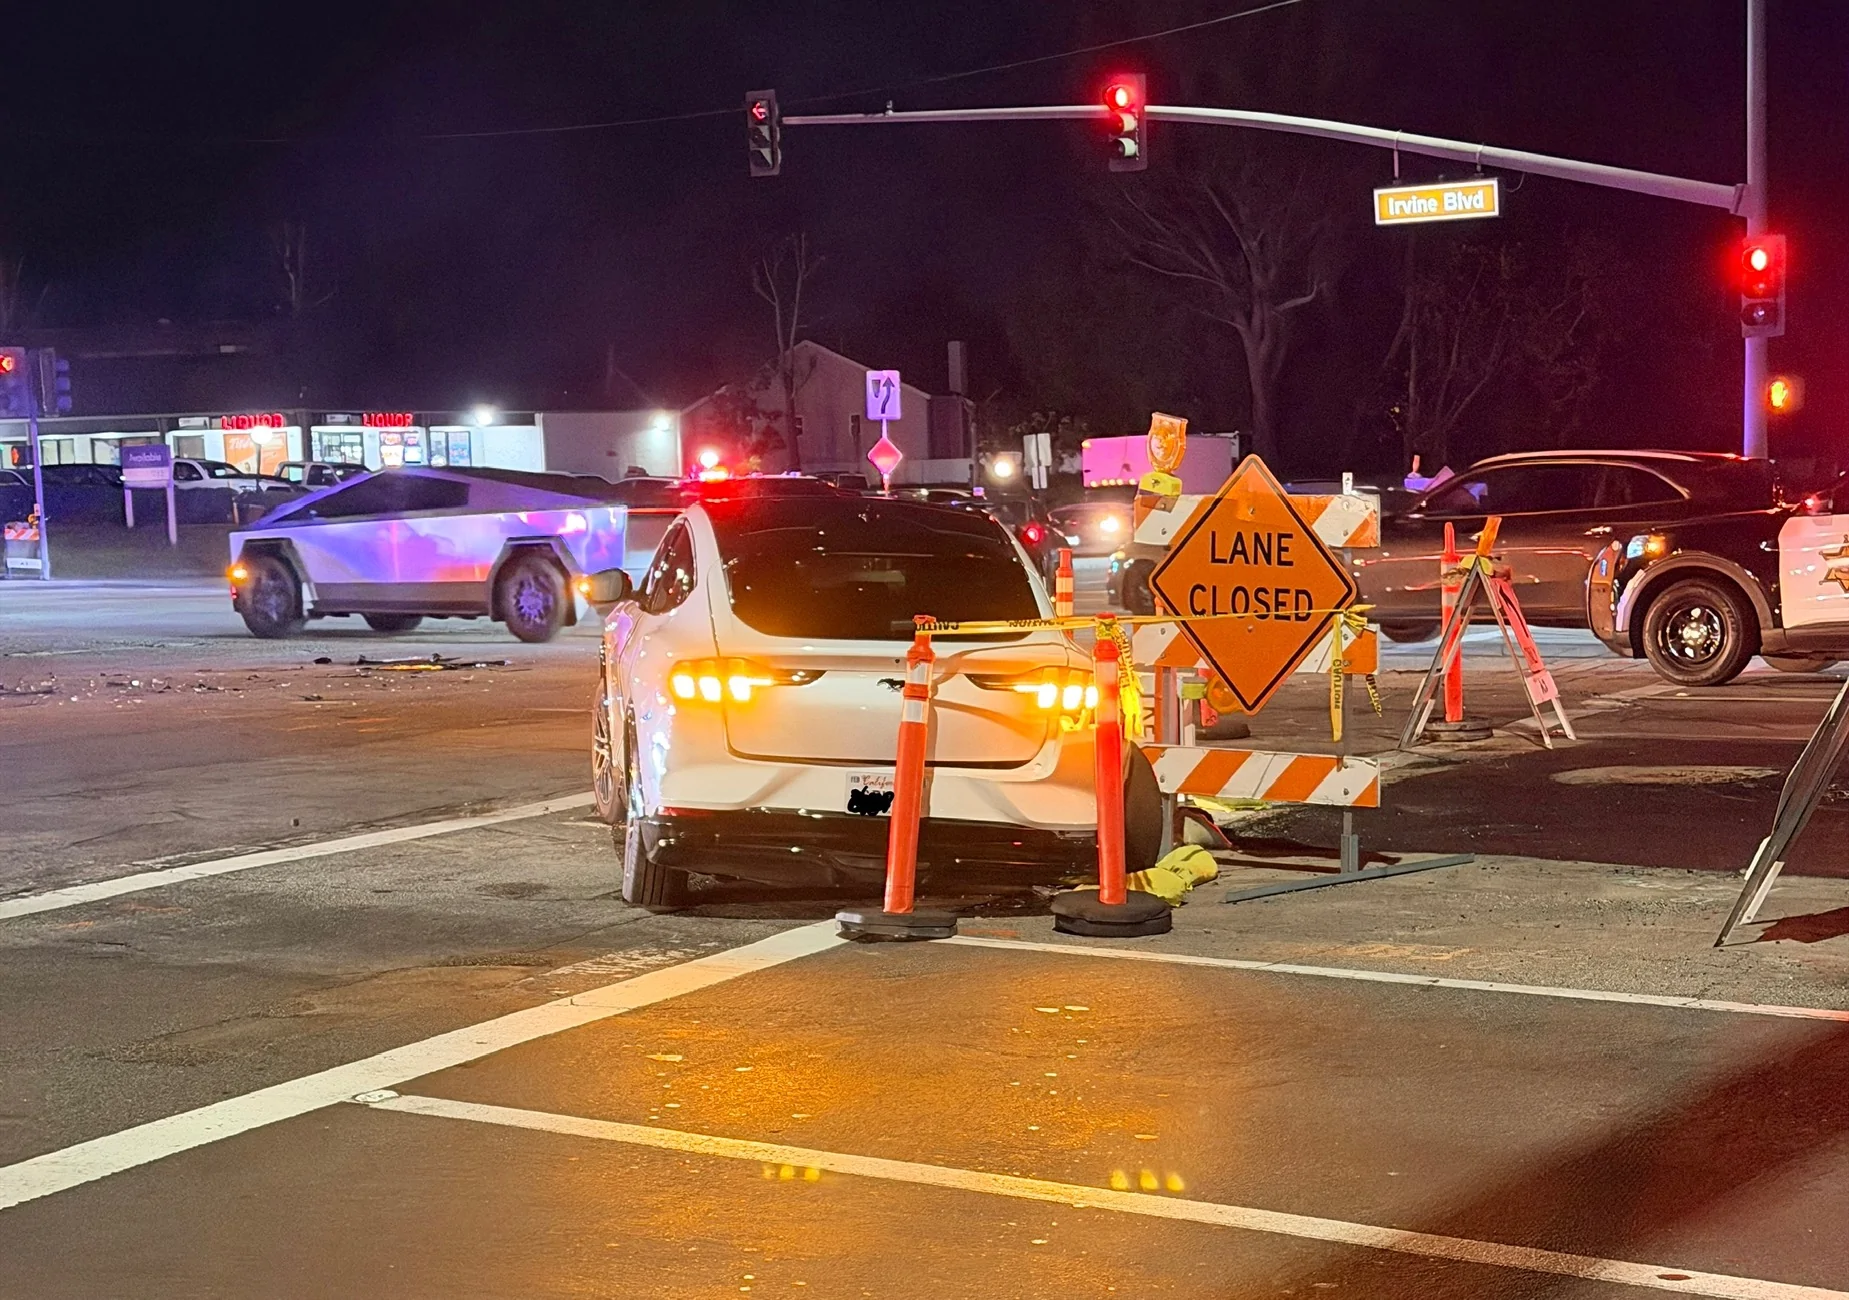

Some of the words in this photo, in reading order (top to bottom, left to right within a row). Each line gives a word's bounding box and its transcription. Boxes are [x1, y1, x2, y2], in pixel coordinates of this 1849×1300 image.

[1388, 195, 1438, 215] Irvine
[1443, 189, 1484, 211] Blvd
[221, 413, 284, 430] LIQUOR
[362, 413, 413, 427] LIQUOR
[1210, 530, 1294, 567] LANE
[1189, 583, 1313, 622] CLOSED
